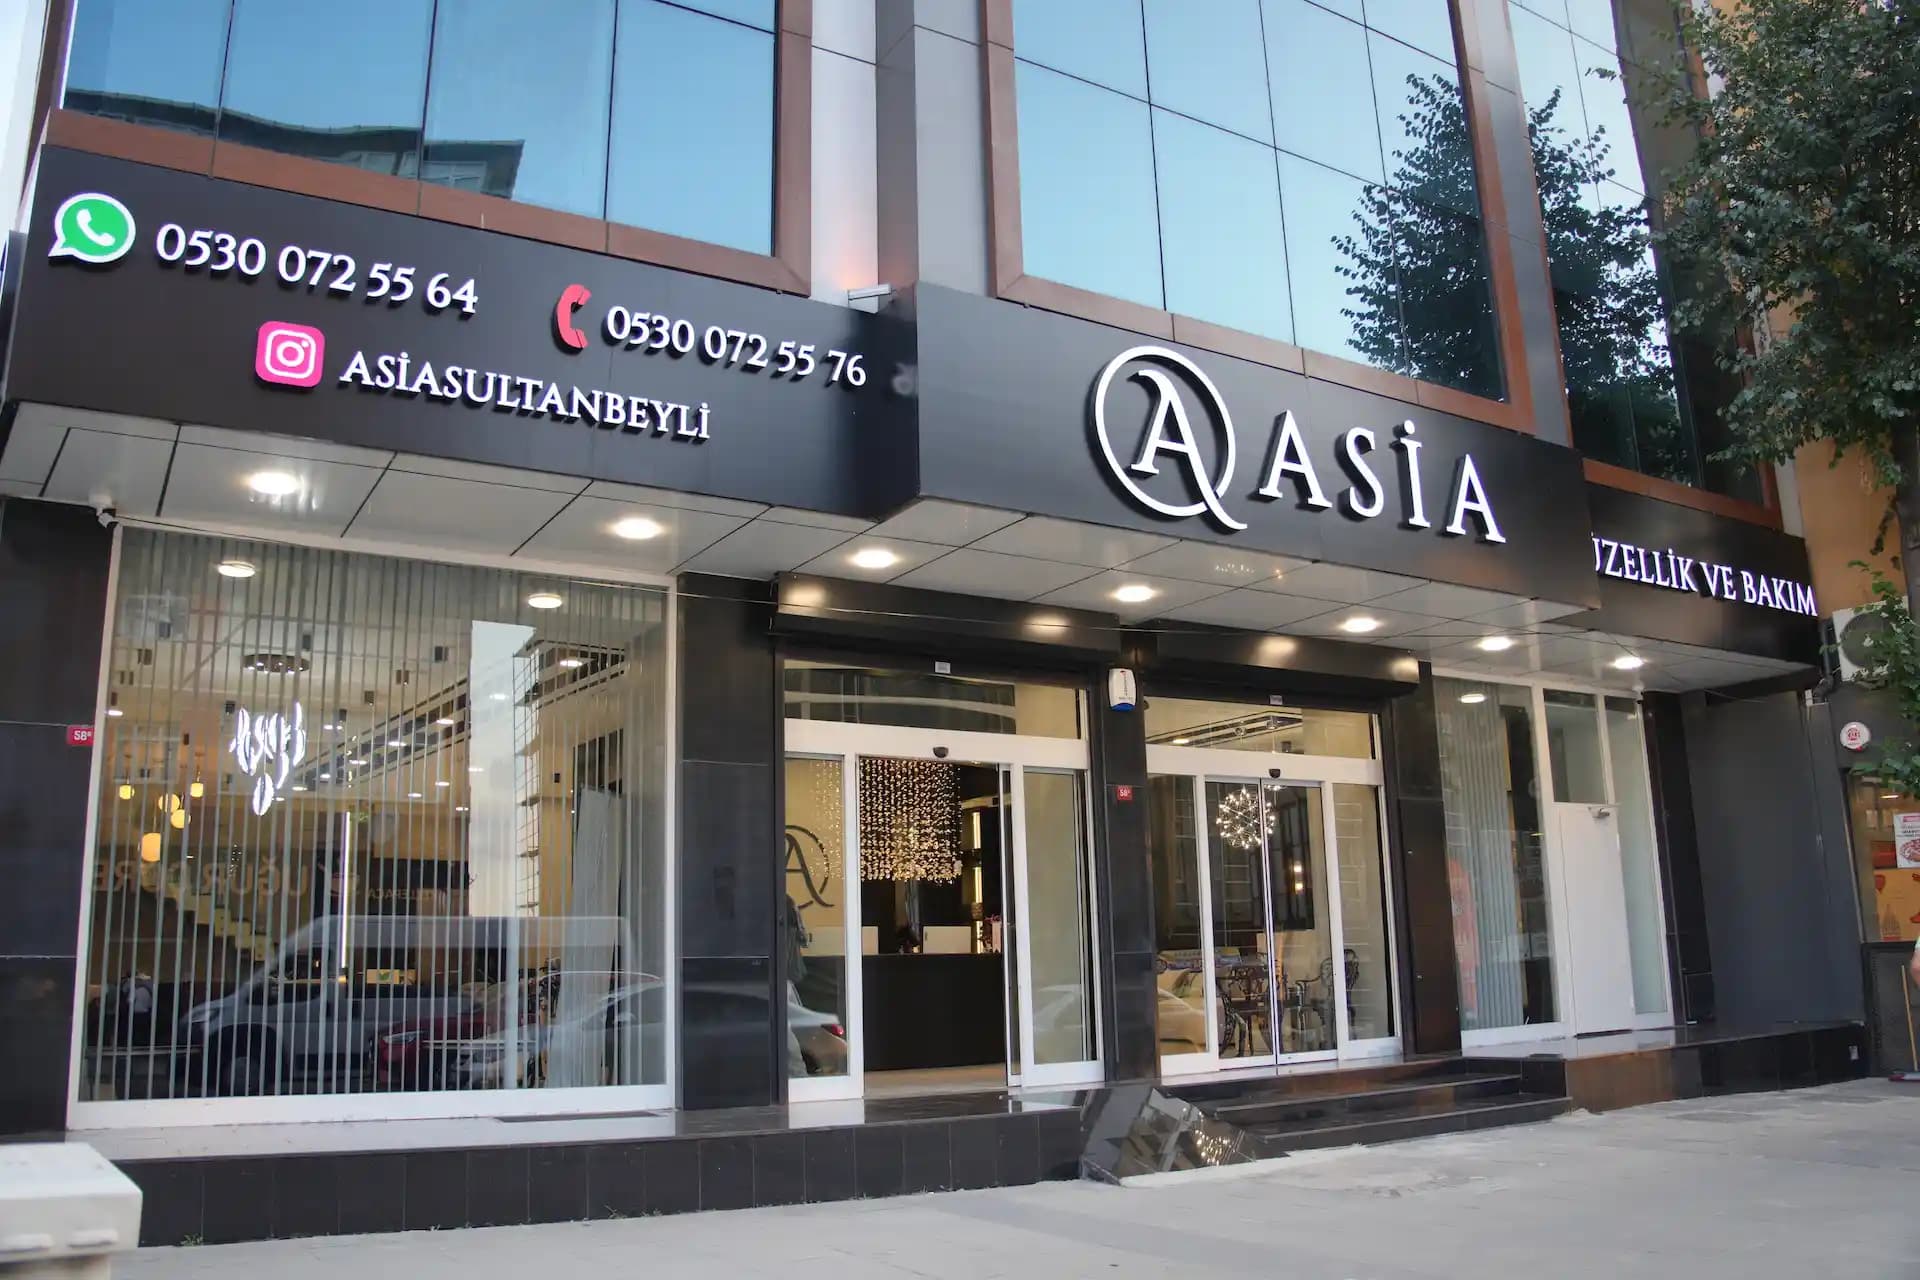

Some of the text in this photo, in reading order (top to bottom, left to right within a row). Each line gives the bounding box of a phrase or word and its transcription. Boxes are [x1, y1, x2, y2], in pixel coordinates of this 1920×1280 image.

[157, 224, 479, 314] 0530 072 55 64
[608, 306, 867, 386] 0530 072 55 76
[340, 351, 711, 439] ASİASULTANBEYLİ
[1259, 410, 1506, 544] ASİA
[1699, 561, 1737, 600] VE
[1740, 570, 1818, 617] BAKIM
